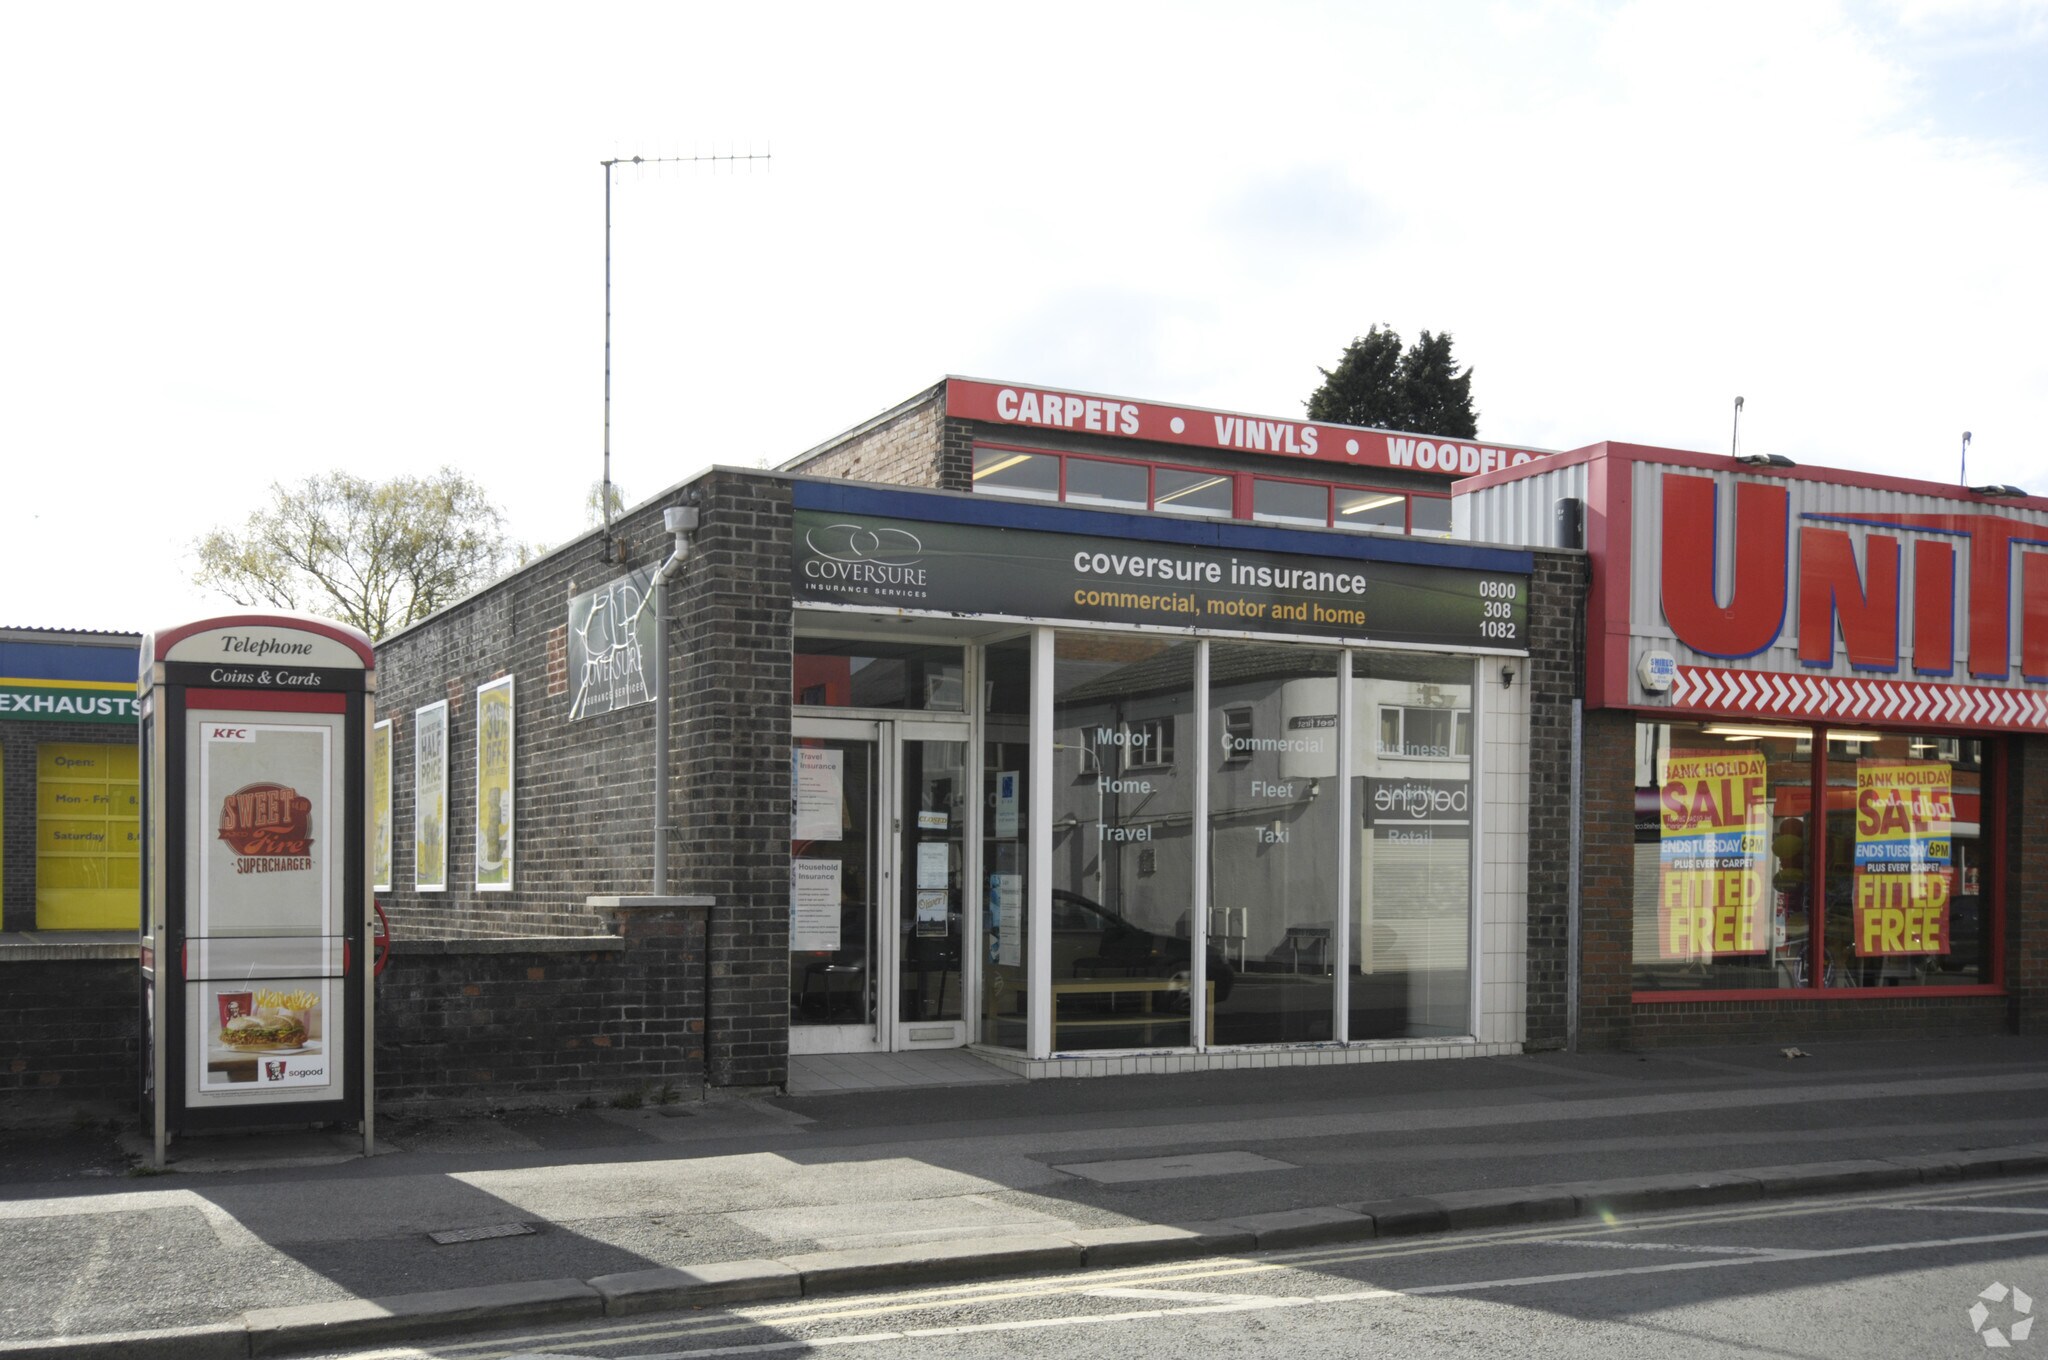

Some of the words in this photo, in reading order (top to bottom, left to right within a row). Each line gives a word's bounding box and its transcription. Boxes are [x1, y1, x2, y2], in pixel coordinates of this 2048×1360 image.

[997, 389, 1139, 435] CARPETS
[1214, 416, 1318, 456] VINYLS
[805, 560, 927, 586] COVERSURE
[1073, 551, 1221, 583] coversure
[1231, 558, 1366, 595] insurance
[806, 583, 868, 594] INSURANCE
[875, 588, 927, 598] SERVICES
[1479, 581, 1516, 599] 0800
[1073, 589, 1200, 616] commercial,
[1207, 599, 1266, 618] motor
[1271, 603, 1307, 621] and
[1313, 602, 1366, 625] home
[1484, 601, 1512, 618] 308
[1479, 620, 1516, 639] 1082
[221, 635, 312, 657] Telephone
[210, 669, 254, 683] Coins
[257, 670, 272, 685] &
[276, 671, 322, 686] Cards
[213, 728, 246, 739] KFC
[1097, 728, 1151, 747] Motor
[1221, 733, 1324, 753] Commercial
[1377, 740, 1448, 757] Business
[54, 756, 96, 769] Open:
[800, 762, 836, 770] Insurance
[1666, 763, 1701, 780] BANK
[1705, 760, 1765, 778] HOLIDAY
[1098, 776, 1151, 794] Home
[1858, 773, 1893, 788] BANK
[1897, 770, 1951, 786] HOLIDAY
[1251, 781, 1293, 798] Fleet
[56, 794, 81, 804] Mon
[1661, 777, 1765, 831] SALE
[224, 787, 296, 831] SWEET
[1858, 787, 1950, 836] SALE
[919, 815, 947, 824] CLOSED
[54, 831, 104, 842] Saturday
[244, 824, 304, 855] Fire
[1096, 824, 1152, 842] Travel
[1255, 826, 1290, 843] Taxi
[1388, 829, 1433, 846] Retail
[1662, 839, 1691, 854] ENDS
[1691, 838, 1740, 853] TUESDAY
[1741, 836, 1763, 852] 6PM
[1856, 844, 1884, 858] ENDS
[1886, 841, 1928, 857] TUESDAY
[1929, 842, 1949, 857] 6PM
[237, 857, 311, 874] SUPERCHARGER
[1674, 859, 1694, 869] PLUS
[1696, 858, 1719, 869] EVERY
[1722, 858, 1753, 868] CARPET
[1867, 863, 1886, 872] PLUS
[1888, 863, 1909, 872] EVERY
[1911, 862, 1939, 872] CARPET
[1665, 870, 1761, 908] FITTED
[1858, 874, 1947, 908] FITTED
[1670, 905, 1754, 954] FREE
[1863, 907, 1940, 952] FREE
